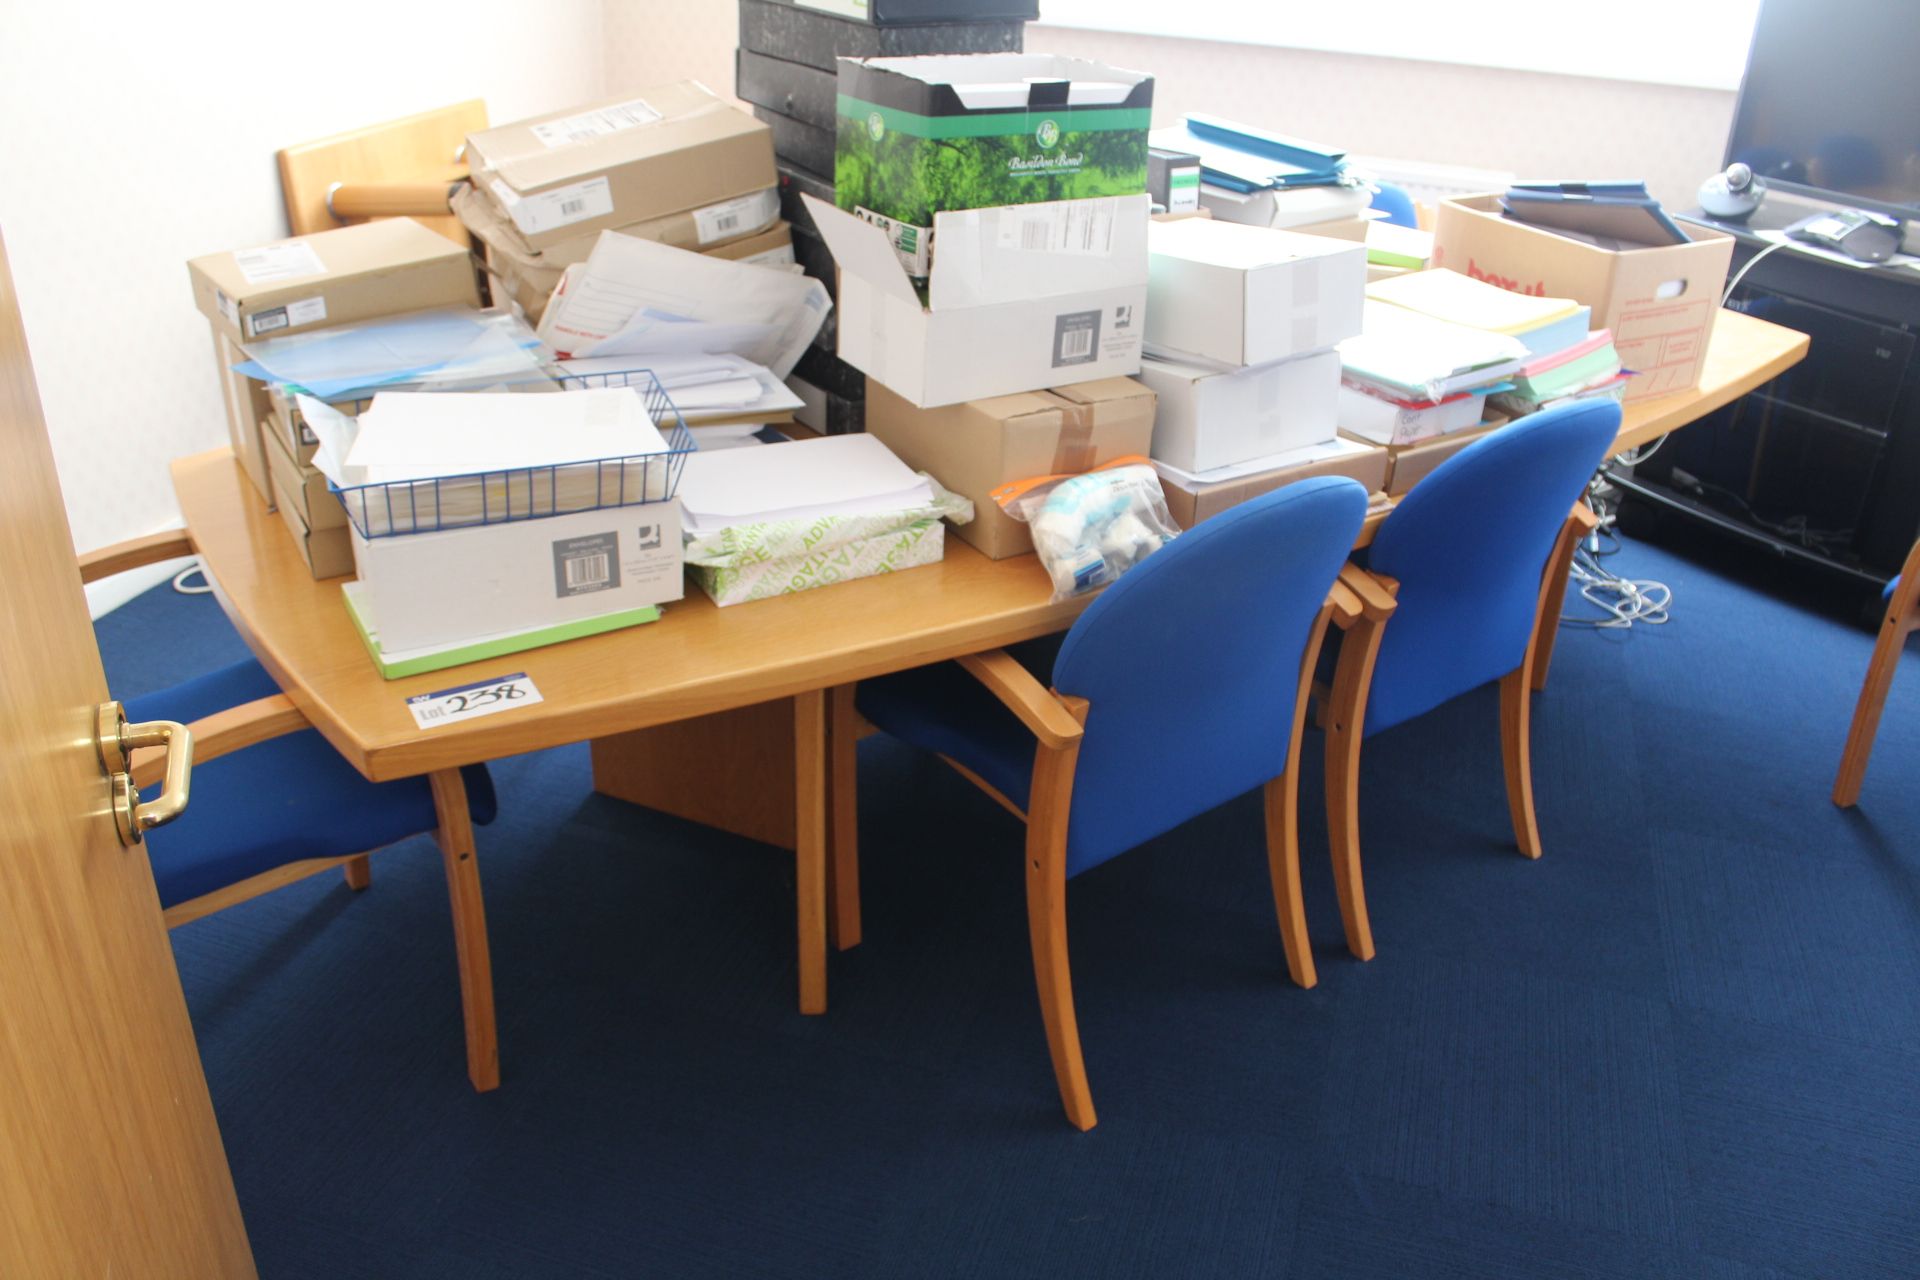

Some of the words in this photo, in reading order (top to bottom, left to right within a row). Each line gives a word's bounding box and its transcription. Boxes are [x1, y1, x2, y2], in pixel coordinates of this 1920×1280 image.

[1008, 154, 1054, 169] Basildon
[1055, 151, 1084, 167] Bond
[446, 684, 527, 714] 238
[419, 705, 447, 721] Lot
